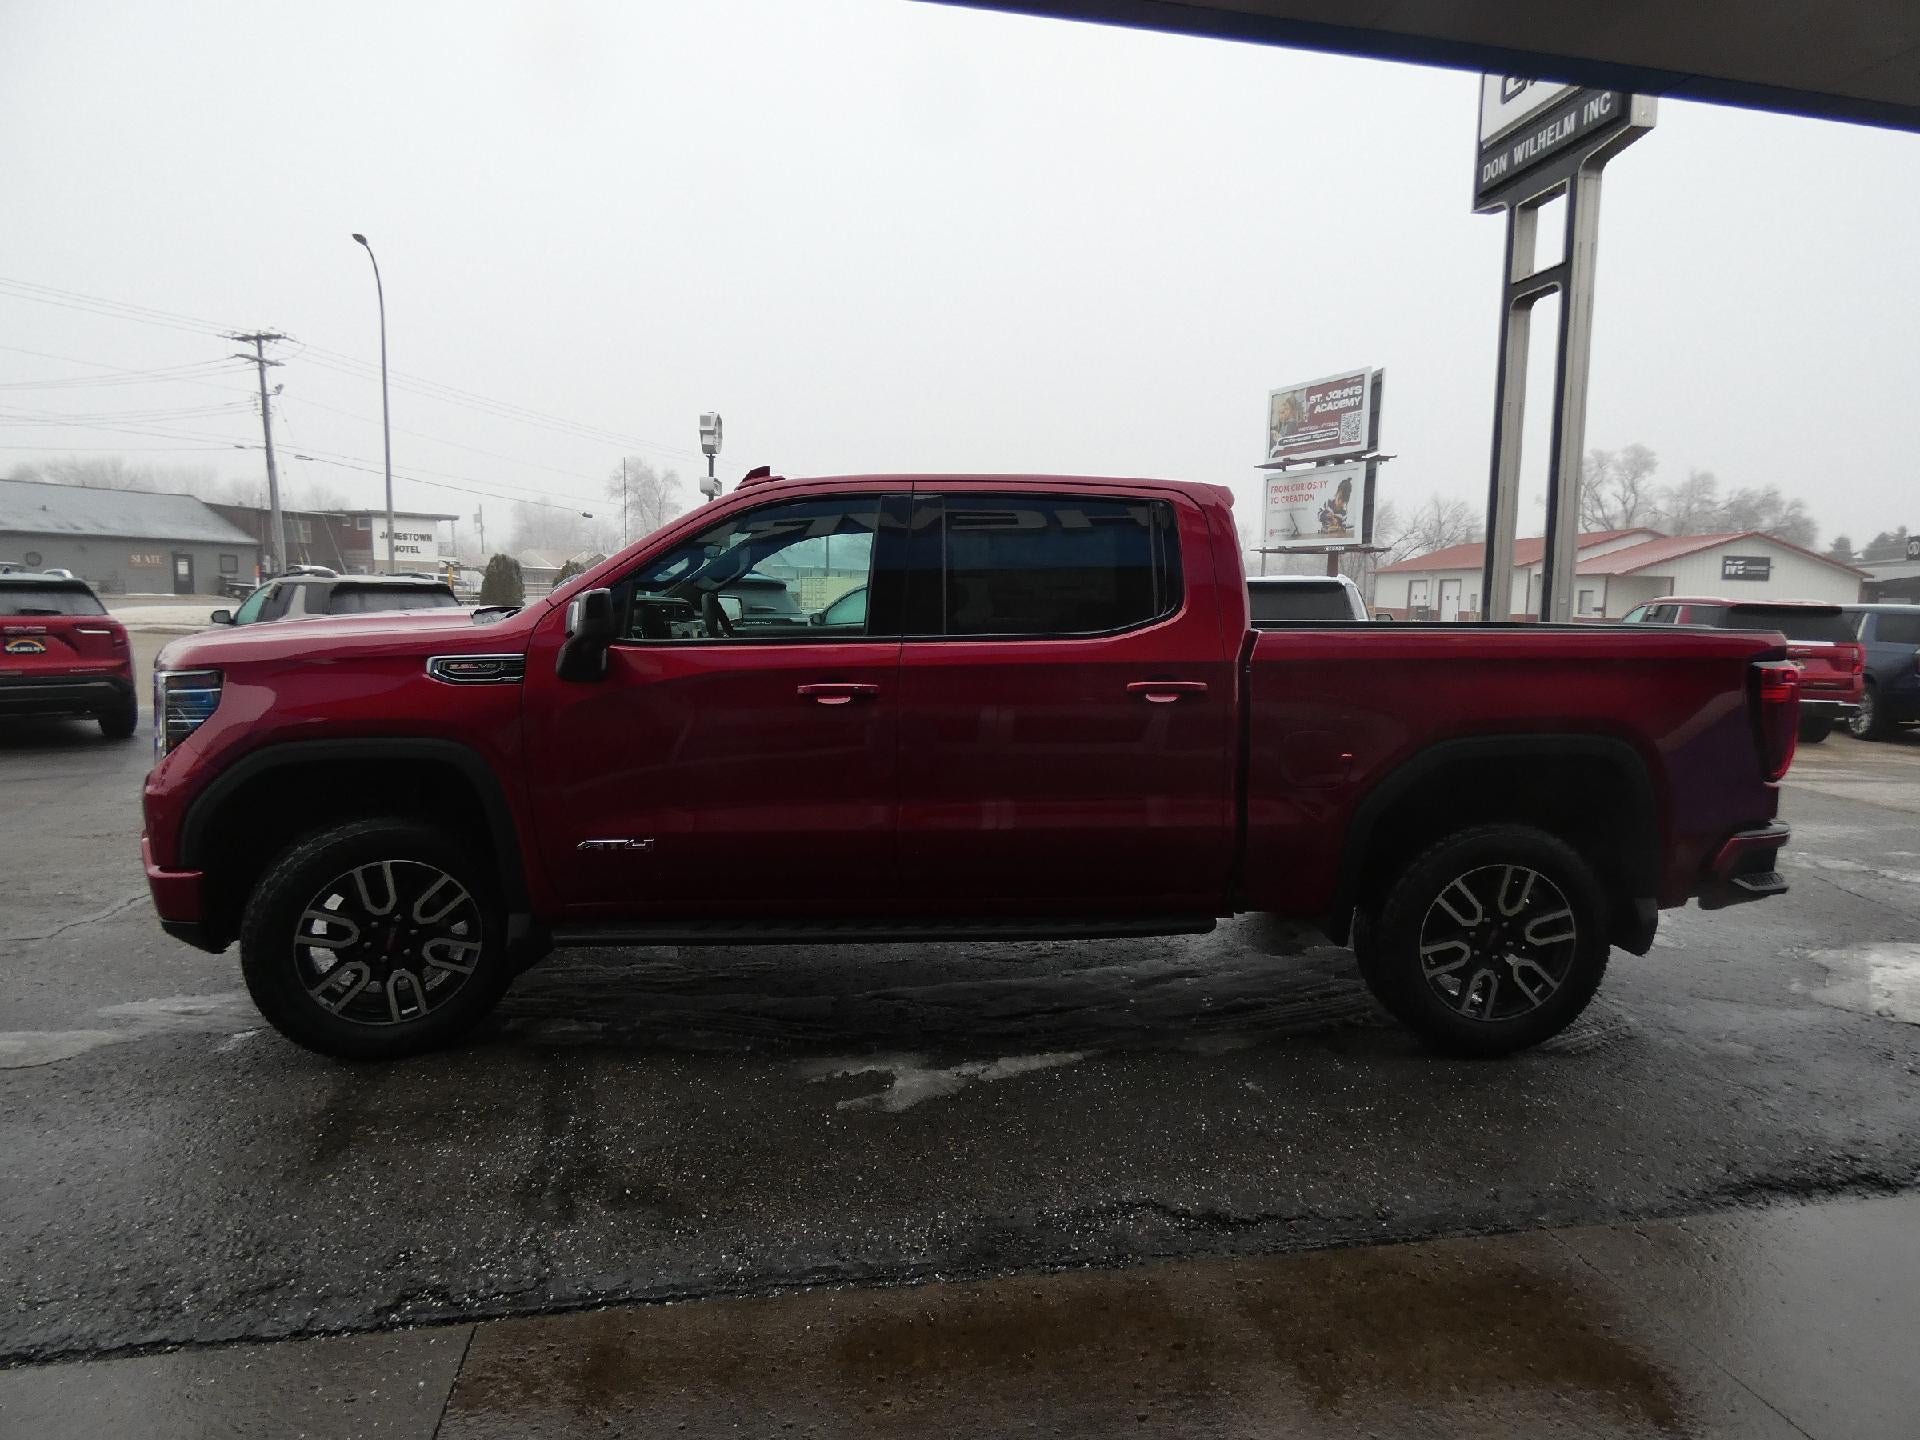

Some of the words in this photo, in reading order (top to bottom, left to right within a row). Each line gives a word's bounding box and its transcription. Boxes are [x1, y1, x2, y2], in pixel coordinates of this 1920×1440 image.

[1483, 154, 1507, 183] DON
[1513, 111, 1576, 166] WILHELM
[1583, 92, 1612, 126] INC
[1314, 396, 1362, 414] ACADEMY
